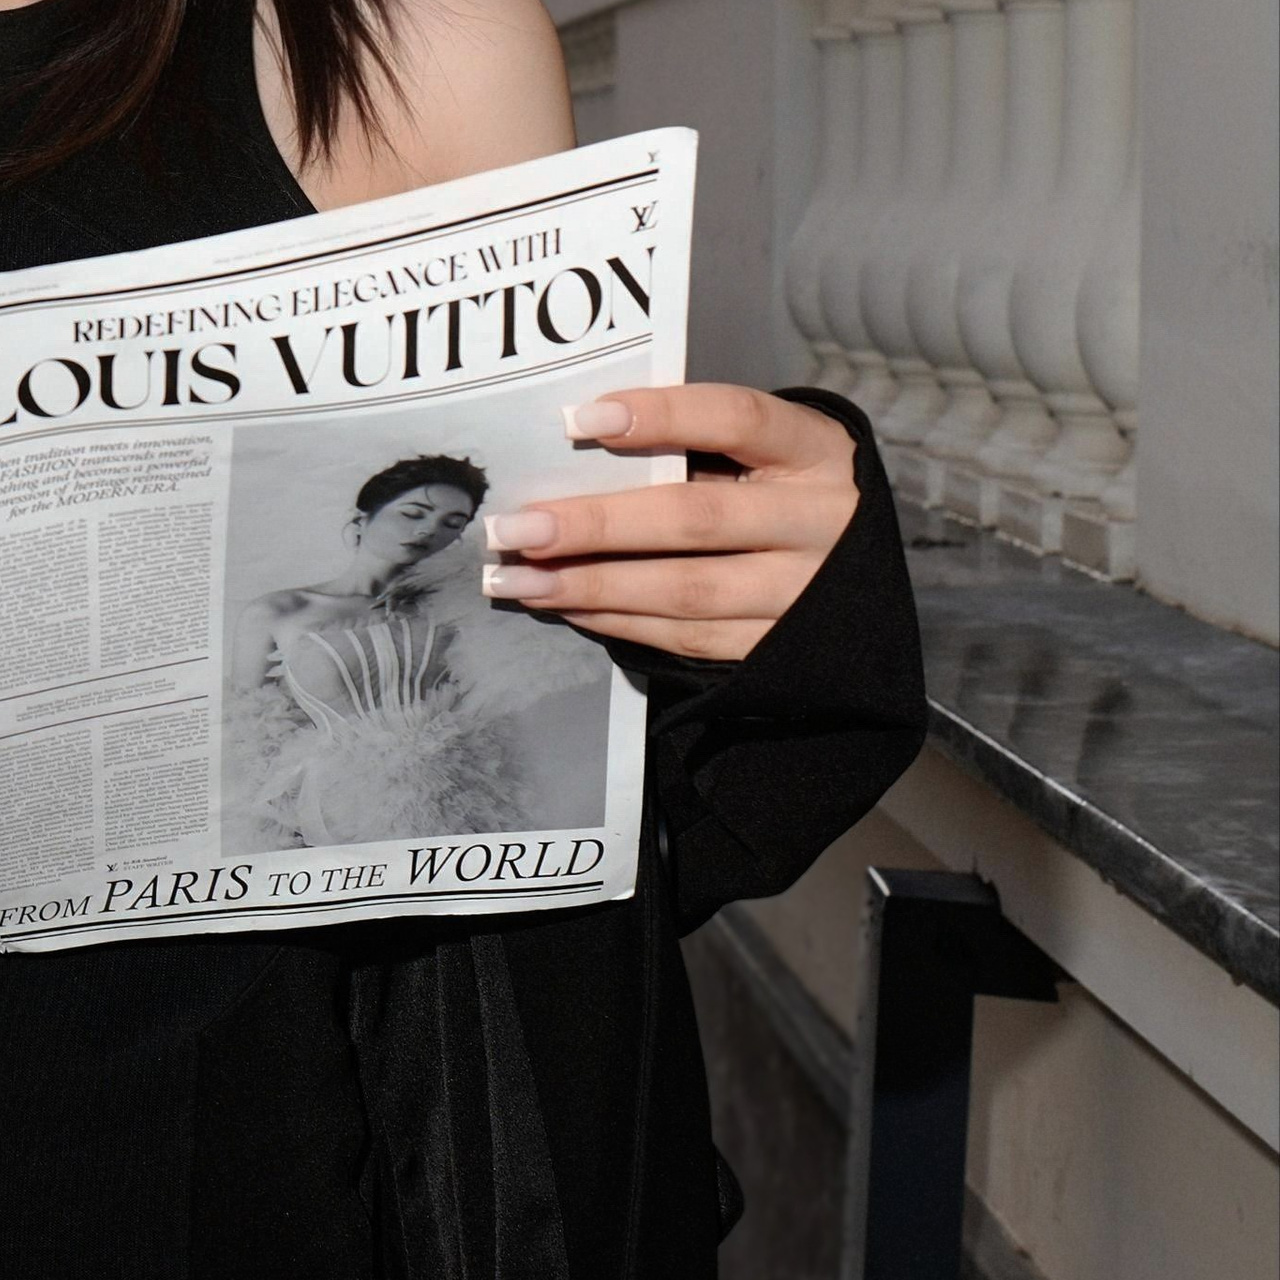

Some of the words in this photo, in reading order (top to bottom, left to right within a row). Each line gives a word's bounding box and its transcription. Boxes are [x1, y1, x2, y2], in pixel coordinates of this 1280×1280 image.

[73, 295, 284, 344] REDEFINING
[292, 250, 469, 317] ELEGANCE
[480, 226, 563, 273] WITH
[272, 245, 656, 396] VUITTON
[0, 457, 77, 482] FASHION
[81, 449, 155, 467] transcends
[158, 448, 194, 458] mere
[24, 445, 86, 464] tradition
[90, 441, 129, 454] meets
[132, 435, 213, 451] innovation,
[42, 472, 70, 486] and
[73, 465, 130, 480] becomes
[133, 464, 142, 472] a
[146, 456, 209, 476] powerful
[53, 484, 69, 498] of
[73, 474, 130, 493] heritage
[132, 467, 212, 487] reimagined
[6, 505, 28, 522] for
[31, 500, 53, 514] the
[56, 485, 136, 508] MODERN
[99, 864, 254, 913] PARIS
[268, 870, 312, 897] TO
[321, 863, 388, 893] THE
[407, 838, 606, 886] WORLD
